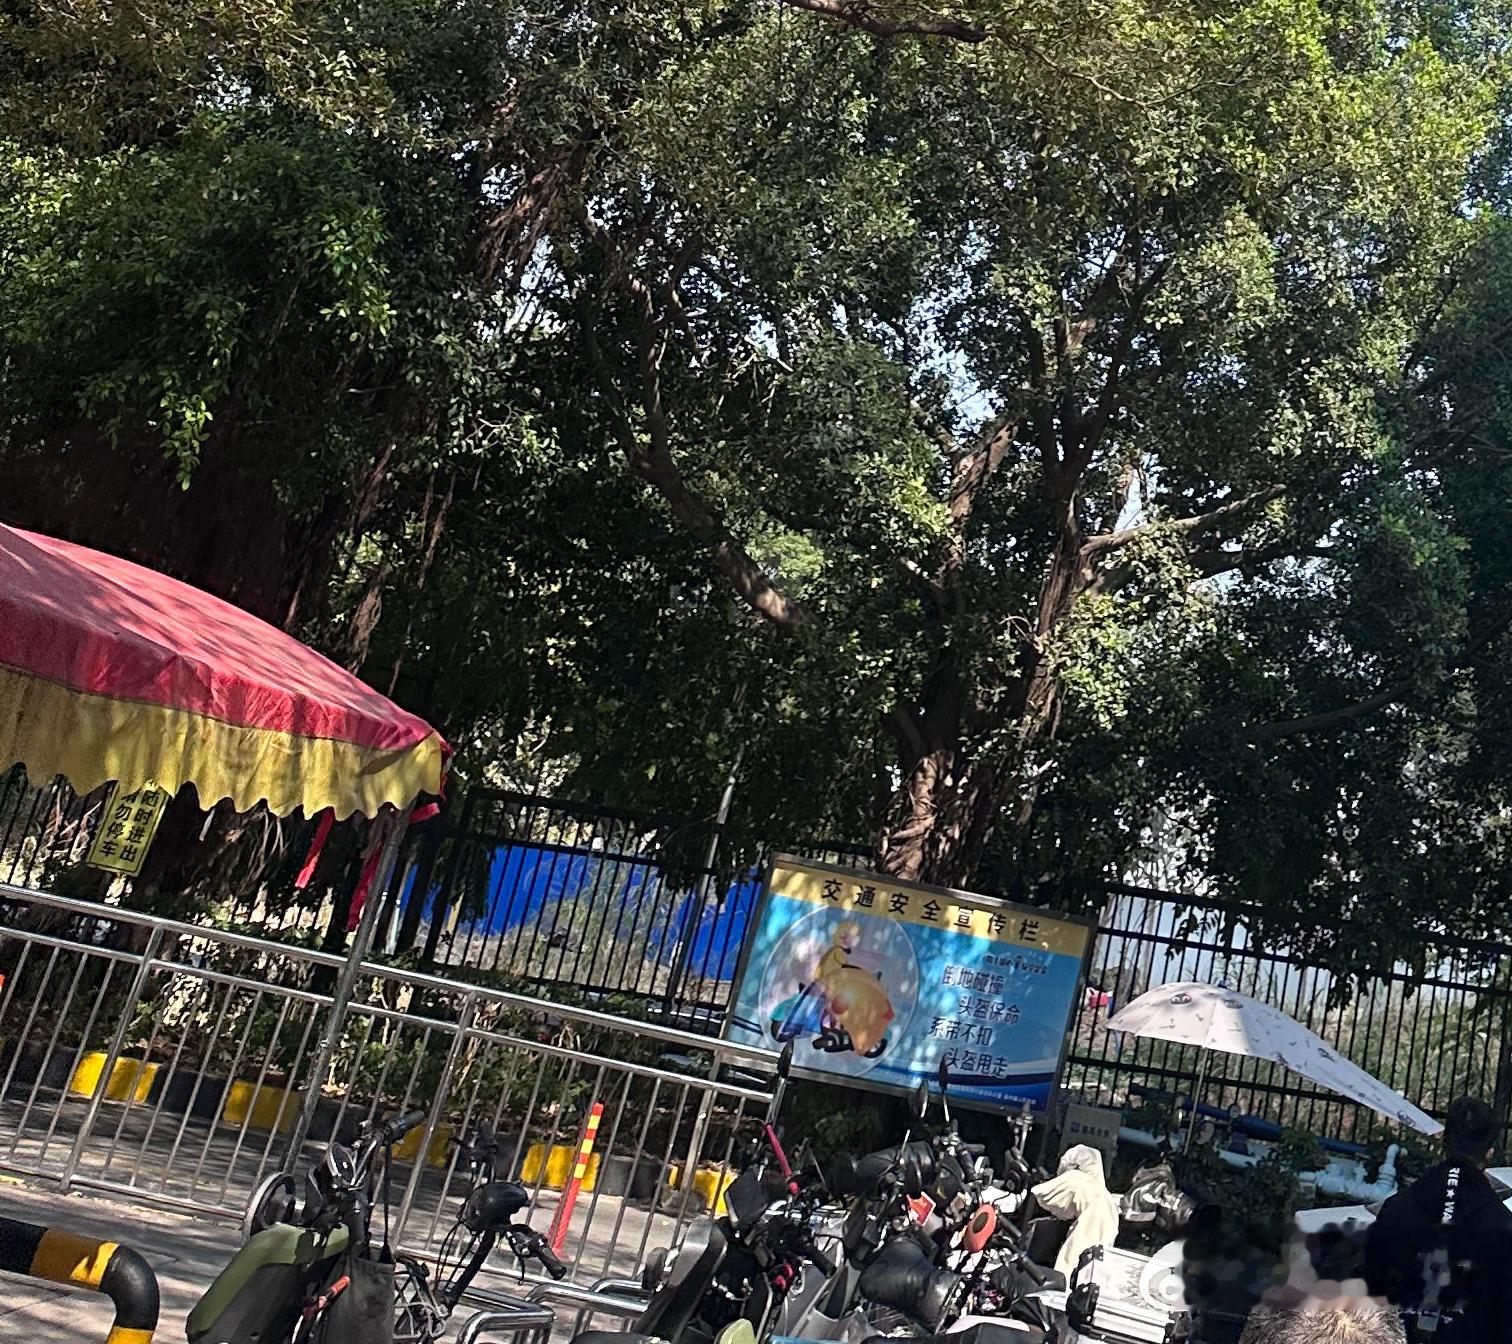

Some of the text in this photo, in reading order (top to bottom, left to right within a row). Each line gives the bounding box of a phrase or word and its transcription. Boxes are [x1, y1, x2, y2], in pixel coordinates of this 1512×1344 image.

[821, 877, 1039, 944] 交通安全宣传栏
[957, 994, 1021, 1025] 头盔保命
